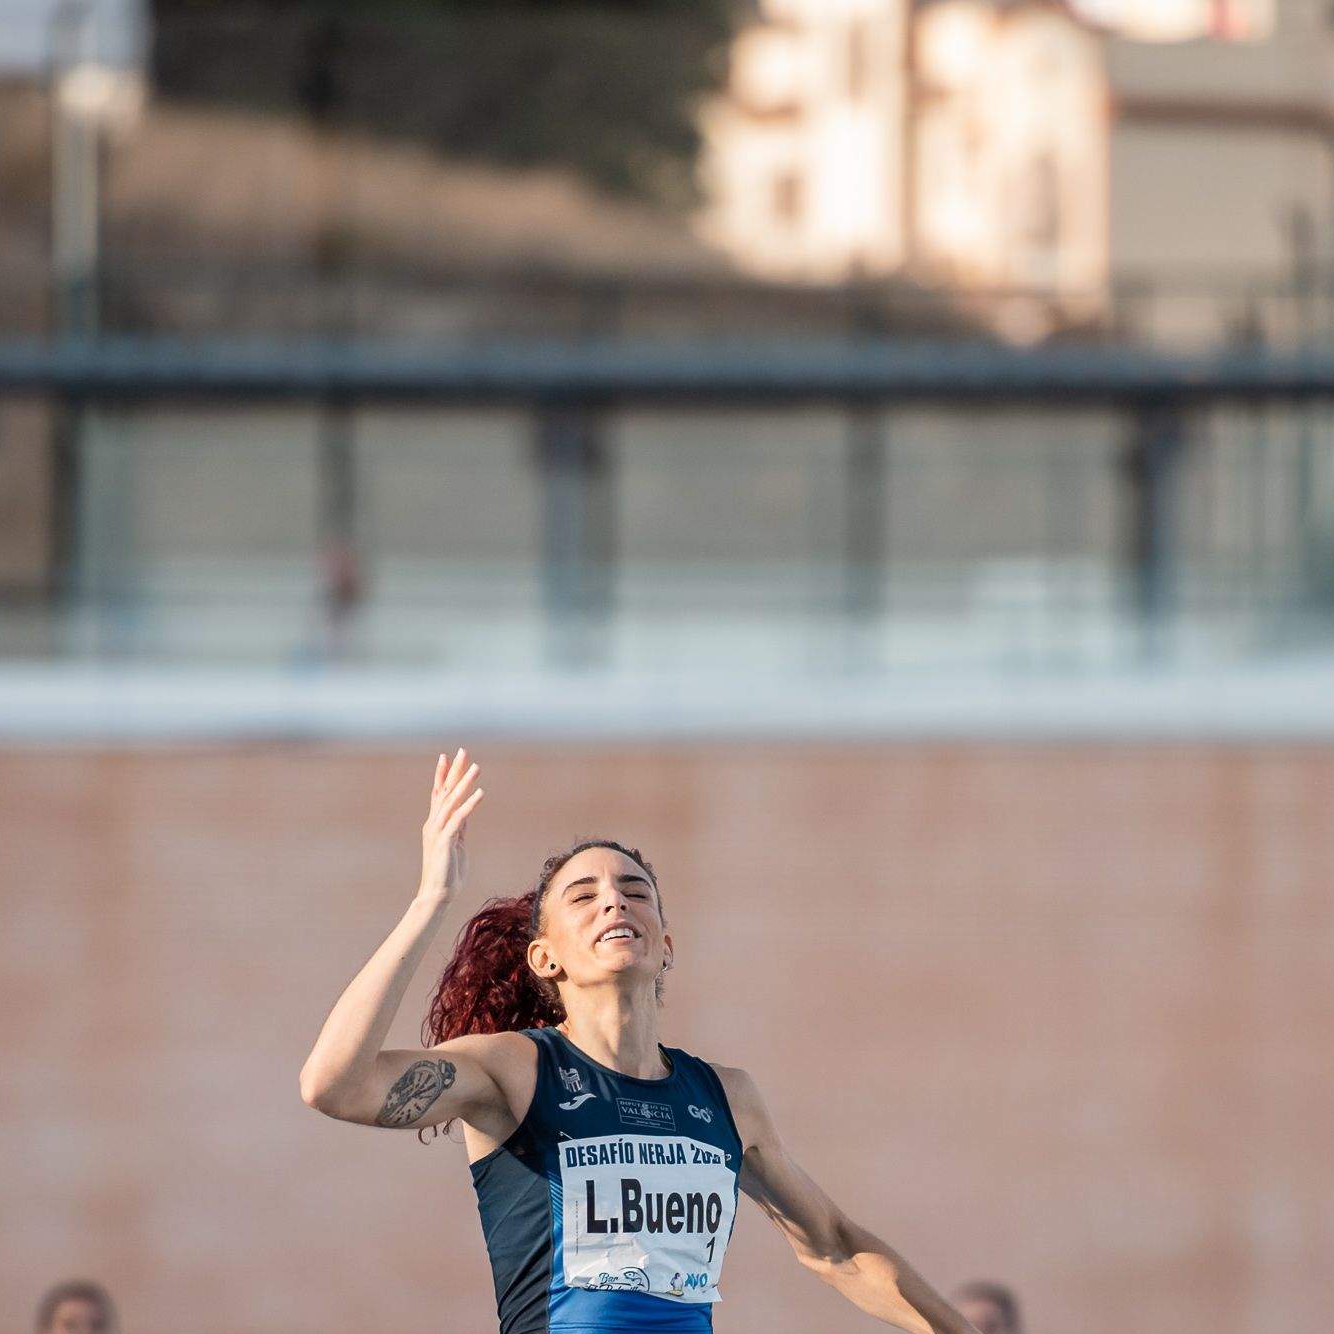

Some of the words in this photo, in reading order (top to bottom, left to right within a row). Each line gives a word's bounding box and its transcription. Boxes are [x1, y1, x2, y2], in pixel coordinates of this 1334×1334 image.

[565, 1138, 634, 1168] DESAFÍO
[638, 1142, 686, 1165] NERJA
[585, 1178, 722, 1234] L.Bueno
[706, 1236, 716, 1263] 1
[599, 1272, 619, 1284] Bar
